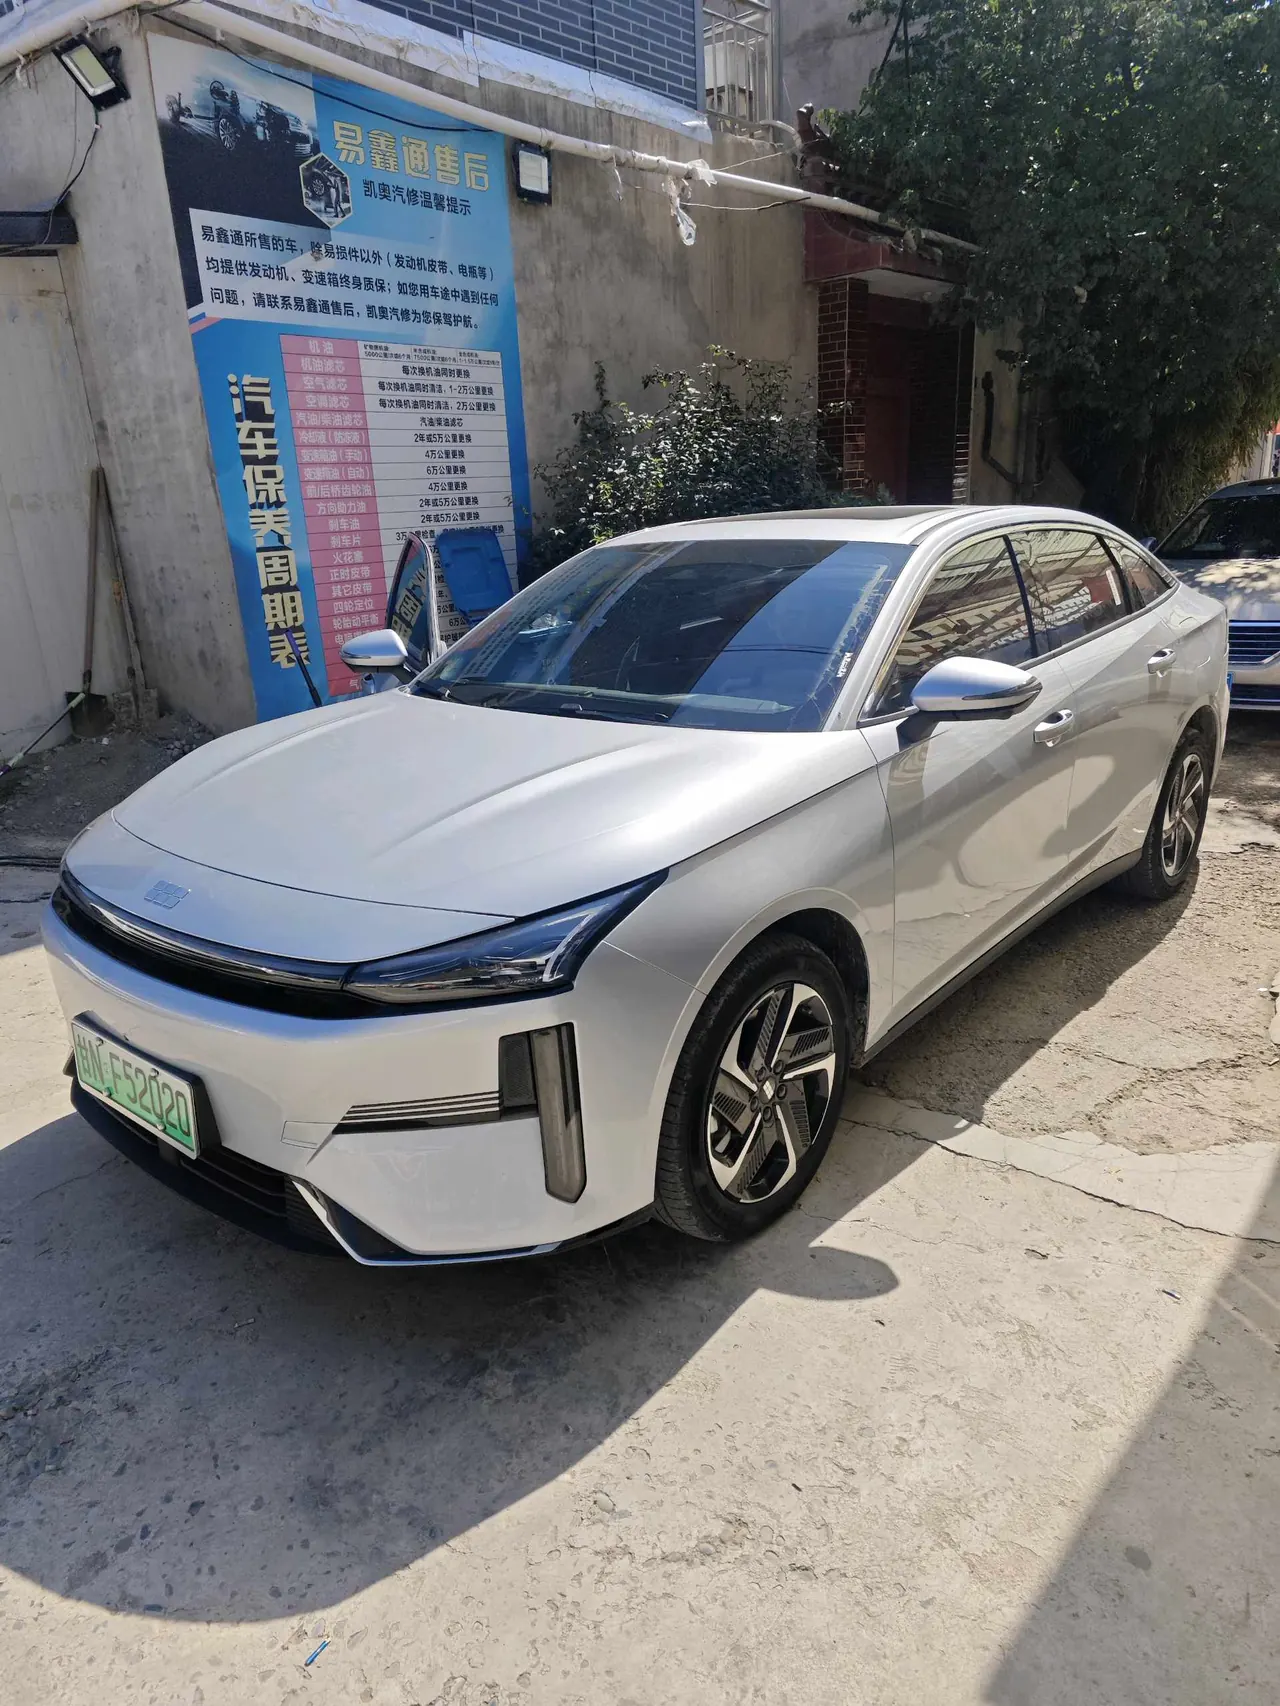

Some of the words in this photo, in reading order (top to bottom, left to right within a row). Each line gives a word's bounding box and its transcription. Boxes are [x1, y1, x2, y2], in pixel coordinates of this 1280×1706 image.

[333, 120, 489, 191] 易鑫通售后
[362, 178, 472, 216] 凯奥汽修温馨提示
[308, 340, 334, 354] 机油
[301, 357, 345, 373] 机油滤芯
[402, 365, 471, 379] 每次换机油同时更换
[303, 376, 348, 391] 空气滤芯
[305, 394, 350, 409] 空调滤芯
[414, 433, 472, 443] 2年或5万公里更换
[425, 449, 465, 459] 4万公里更换
[426, 465, 466, 475] 6万公里更换
[428, 481, 468, 492] 4万公里更换
[316, 501, 366, 515] 方向助力油
[419, 496, 479, 508] 2年或5万公里更换
[227, 373, 311, 669] 汽车保养周期表
[421, 511, 480, 523] 2年或5万公里更换
[328, 518, 360, 531] 刹车油
[330, 534, 362, 548] 刹车片
[333, 551, 363, 564] 火花塞
[330, 567, 370, 581] 正时皮带
[332, 584, 372, 598] 其它皮带
[333, 599, 374, 613] 四轮定位
[333, 613, 379, 630] 轮胎动平衡
